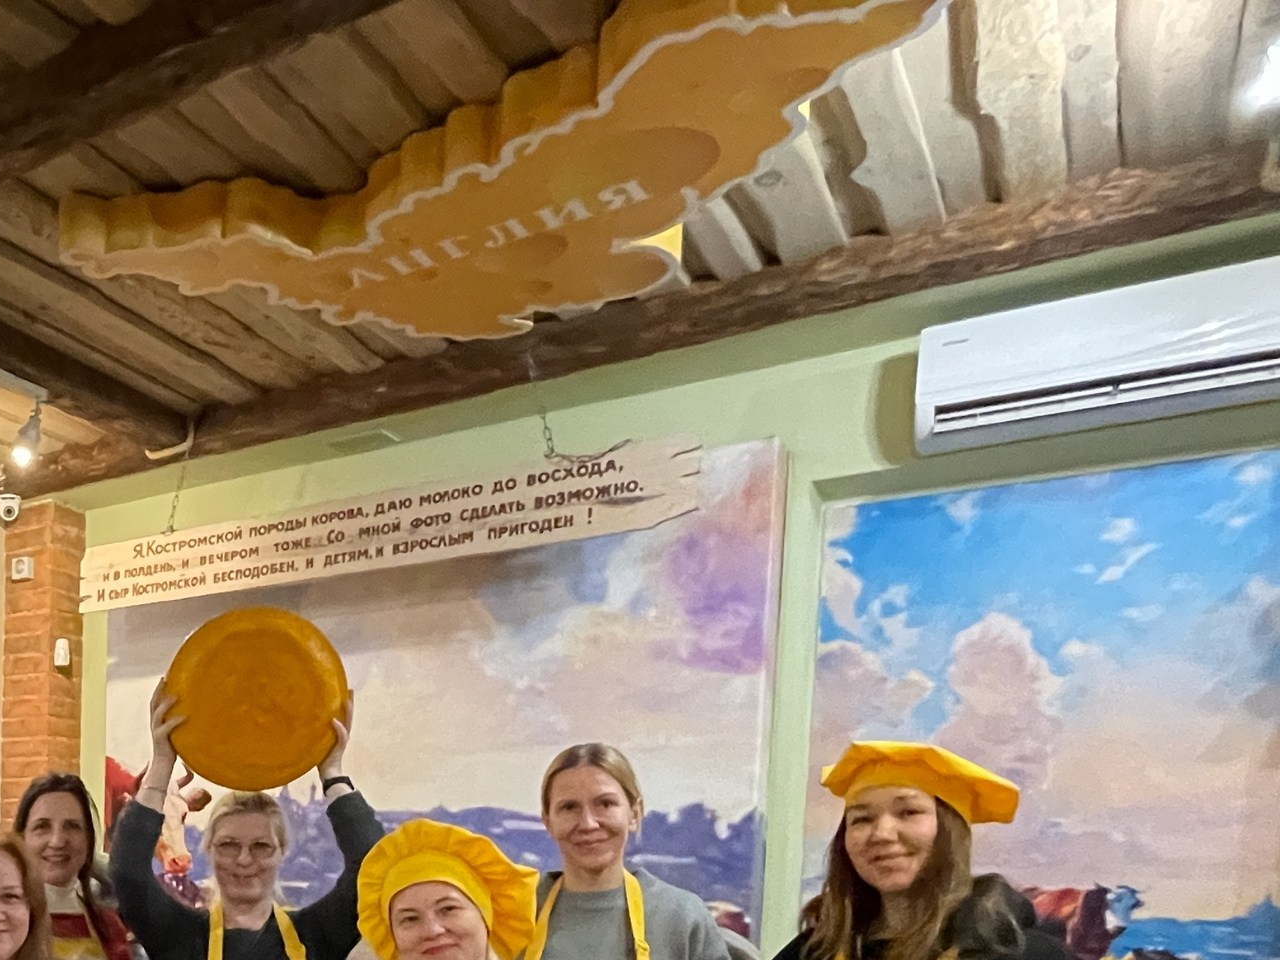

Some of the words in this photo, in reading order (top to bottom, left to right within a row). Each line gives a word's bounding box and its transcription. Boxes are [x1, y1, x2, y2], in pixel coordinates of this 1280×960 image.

[103, 573, 110, 582] И
[114, 571, 120, 581] В
[182, 559, 189, 569] И
[200, 546, 259, 566] ВЕЧЕРОМ
[359, 516, 401, 539] МНОЙ
[410, 512, 451, 529] ФОТО
[460, 500, 525, 522] СДЕЛАТЬ
[534, 480, 644, 510] ВОЗМОЖНО.
[249, 517, 307, 538] ПОРОДЫ
[312, 507, 369, 527] КОРОВА,
[374, 498, 413, 517] ДАЮ
[420, 484, 483, 506] МОЛОКО
[491, 478, 517, 495] ДО
[526, 459, 624, 487] ВОСХОДА,
[97, 589, 105, 602] И
[109, 588, 129, 600] СЫР
[392, 531, 474, 555] ВЗРОСЛЫМ
[488, 515, 574, 540] ПРИГОДЕН
